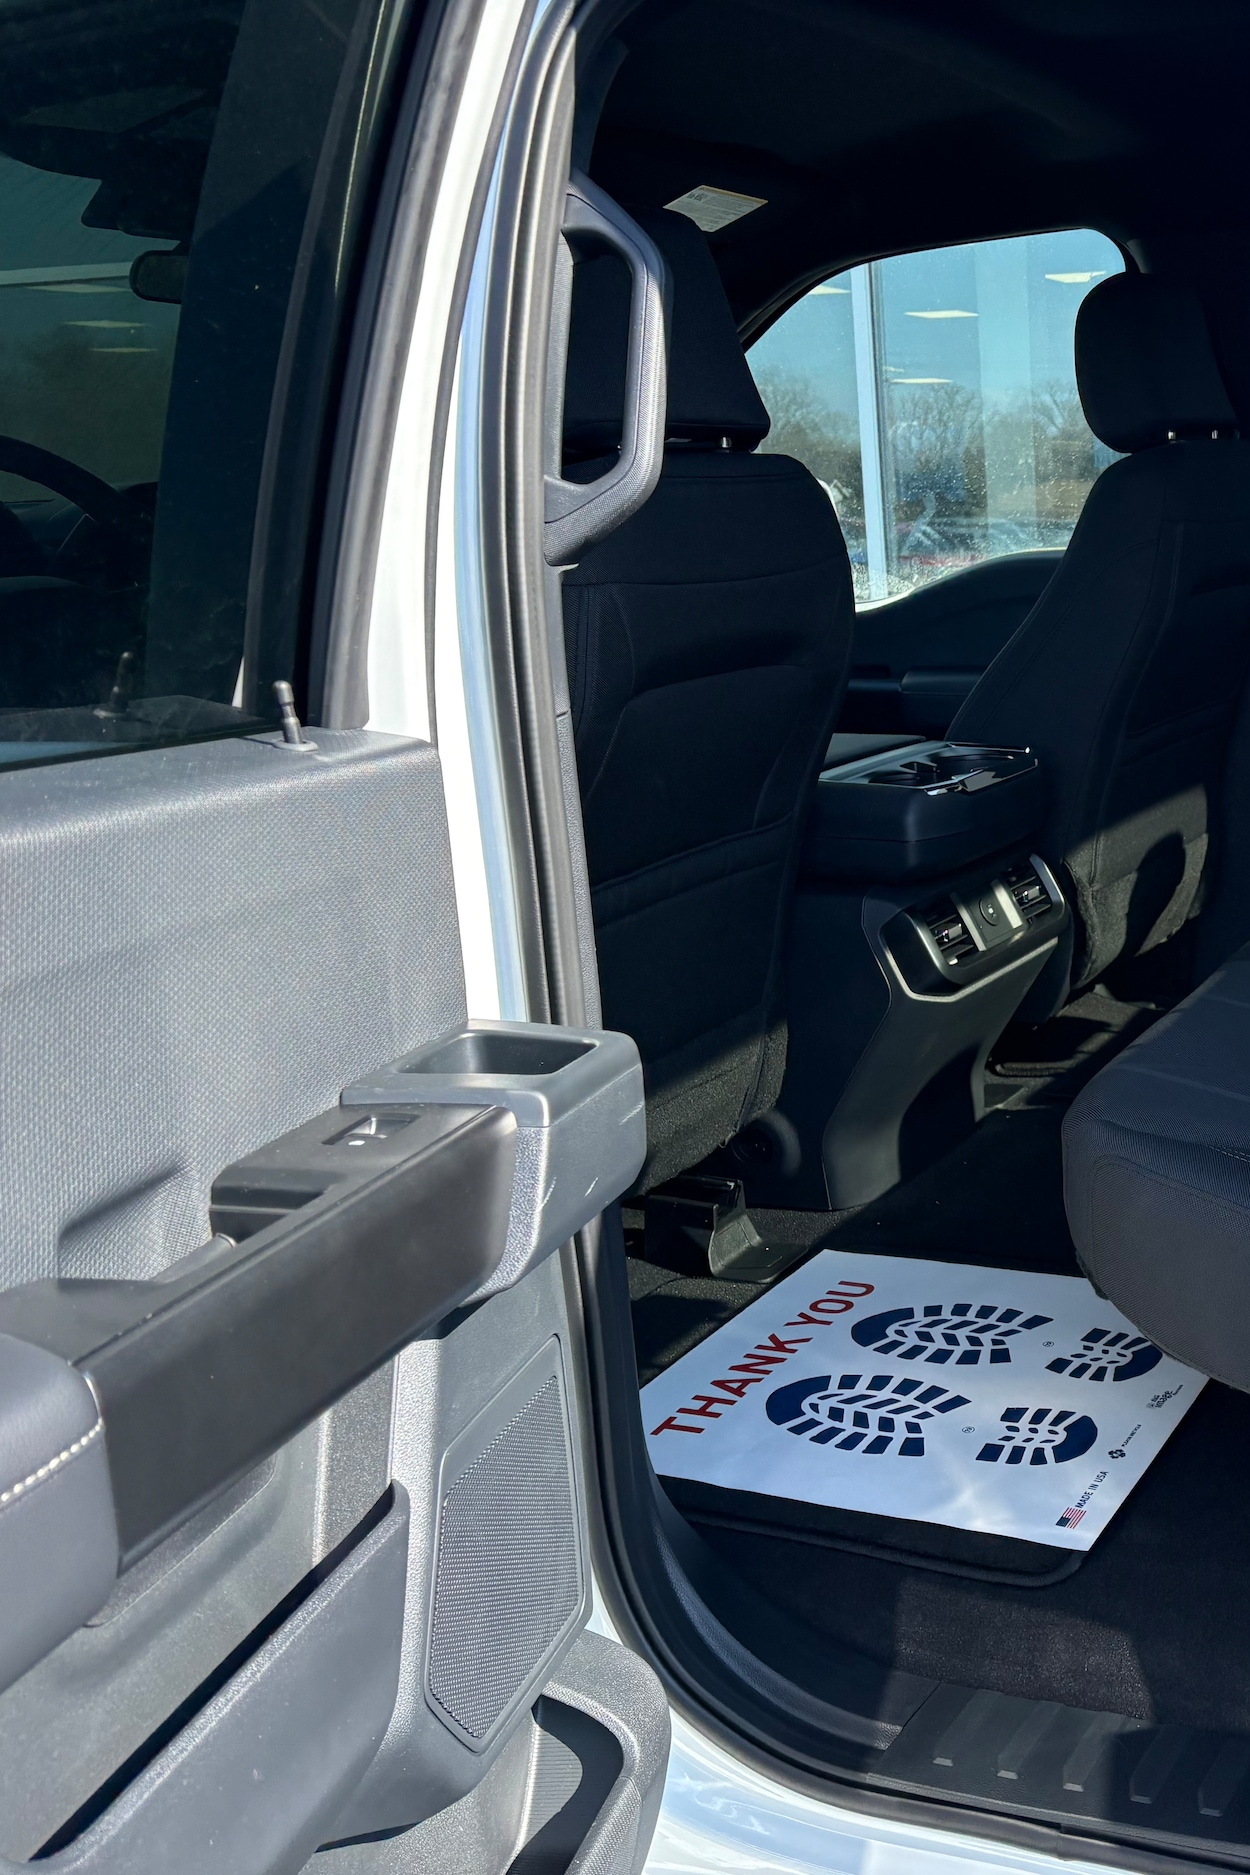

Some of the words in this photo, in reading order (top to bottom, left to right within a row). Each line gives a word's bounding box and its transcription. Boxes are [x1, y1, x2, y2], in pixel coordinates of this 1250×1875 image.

[650, 1333, 813, 1435] THANK
[783, 1280, 875, 1327] YOU
[1074, 1491, 1094, 1509] MADE
[1088, 1483, 1099, 1492] IN
[1094, 1471, 1109, 1484] USA
